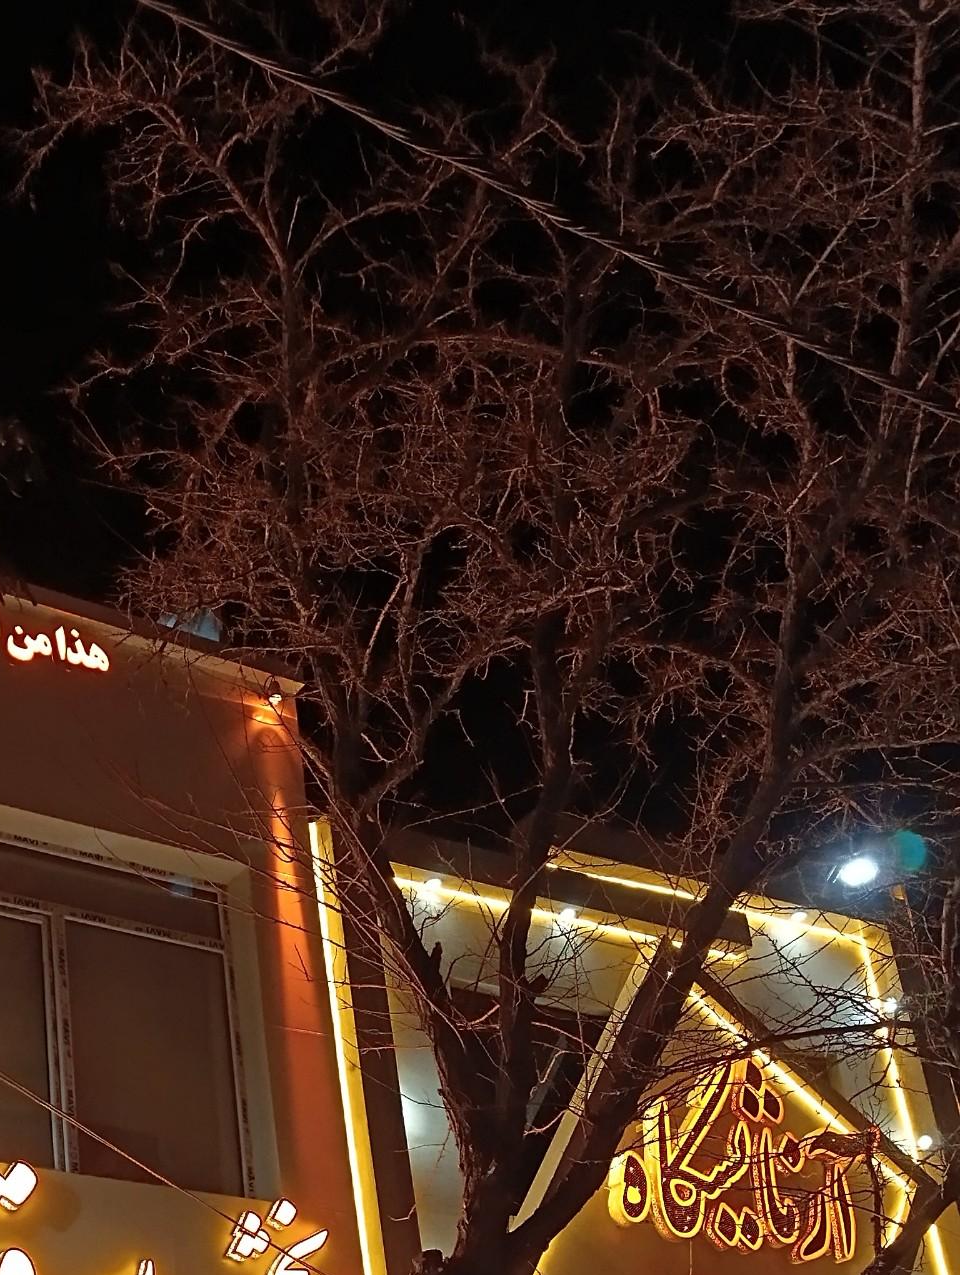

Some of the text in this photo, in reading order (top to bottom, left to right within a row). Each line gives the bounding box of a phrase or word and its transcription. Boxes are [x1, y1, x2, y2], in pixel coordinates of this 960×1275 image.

[7, 625, 52, 661] من
[54, 626, 110, 671] هذا
[608, 1058, 877, 1264] آزمایشگاه
